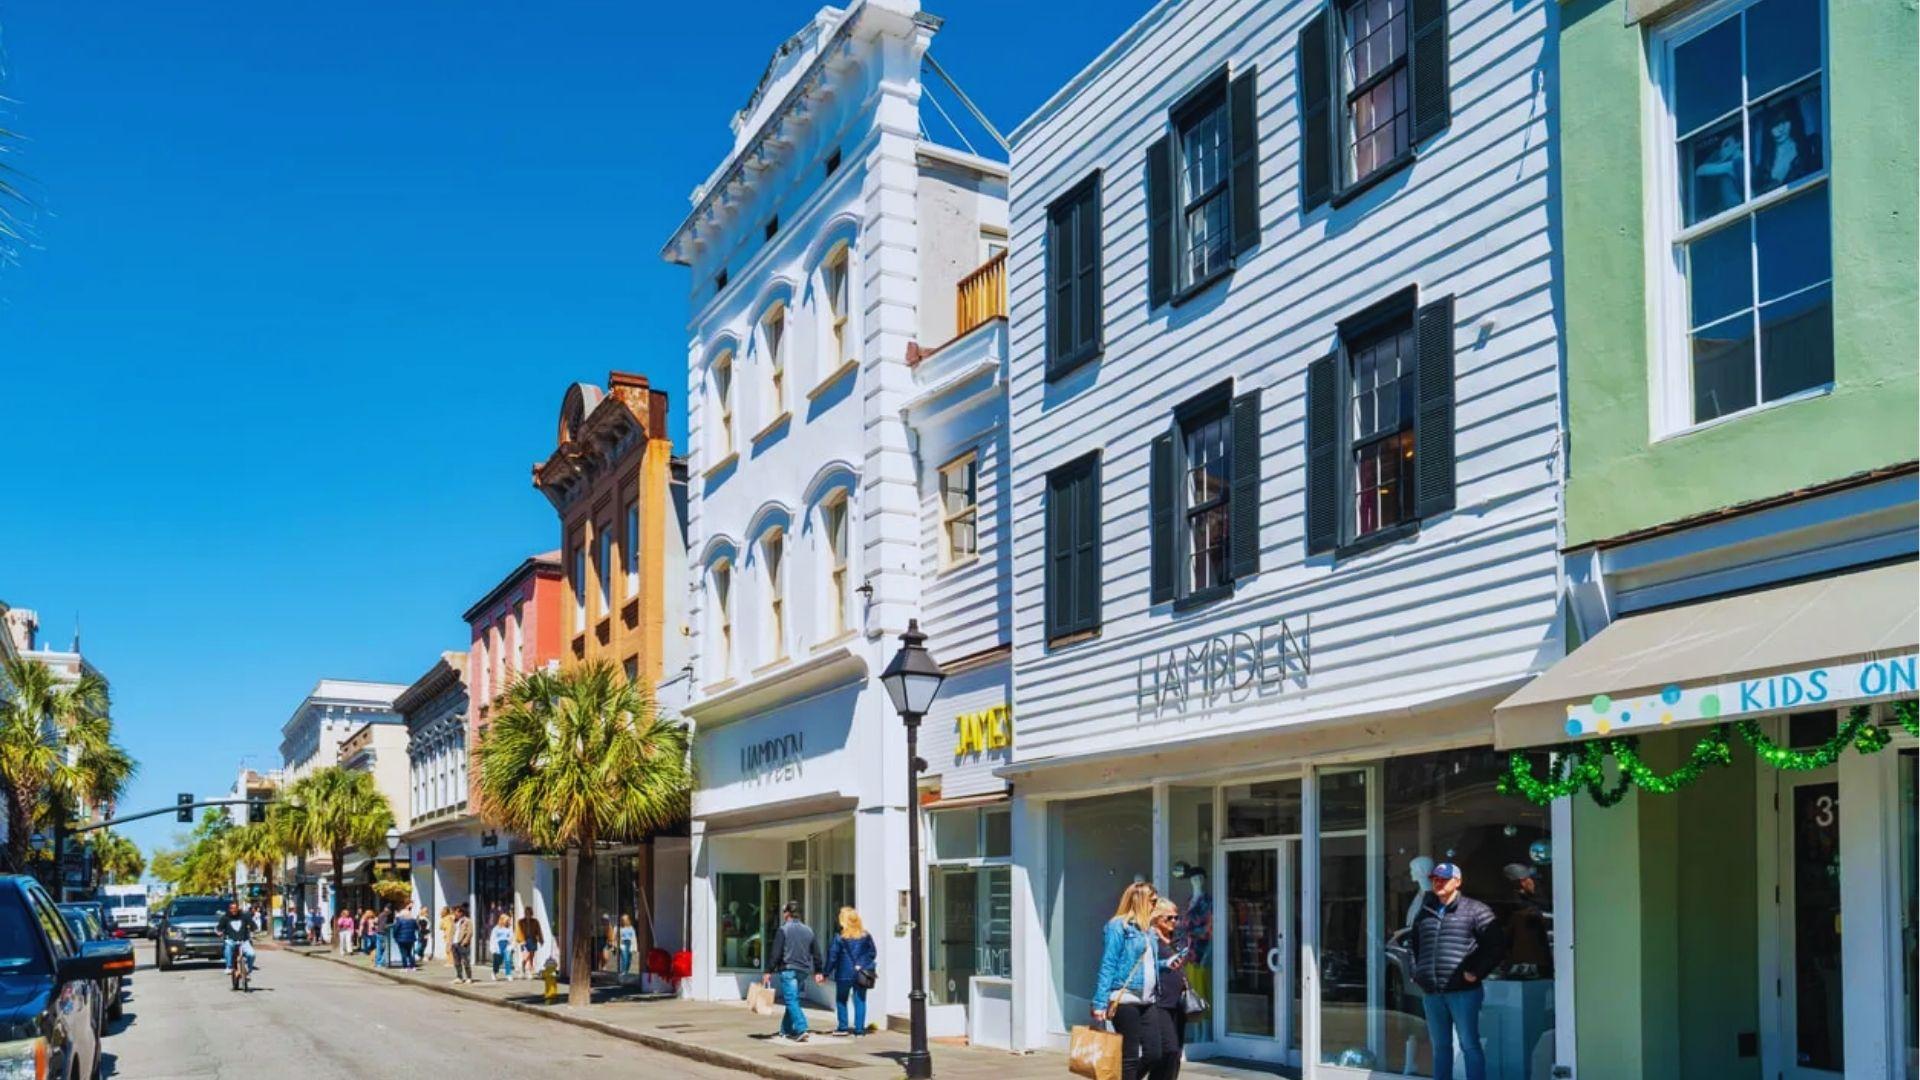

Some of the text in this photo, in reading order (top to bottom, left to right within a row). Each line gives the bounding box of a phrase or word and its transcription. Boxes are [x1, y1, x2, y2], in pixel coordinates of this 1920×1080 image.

[1137, 612, 1311, 711] HAMPDEN
[1740, 669, 1829, 712] KIDS
[1815, 795, 1840, 827] 3
